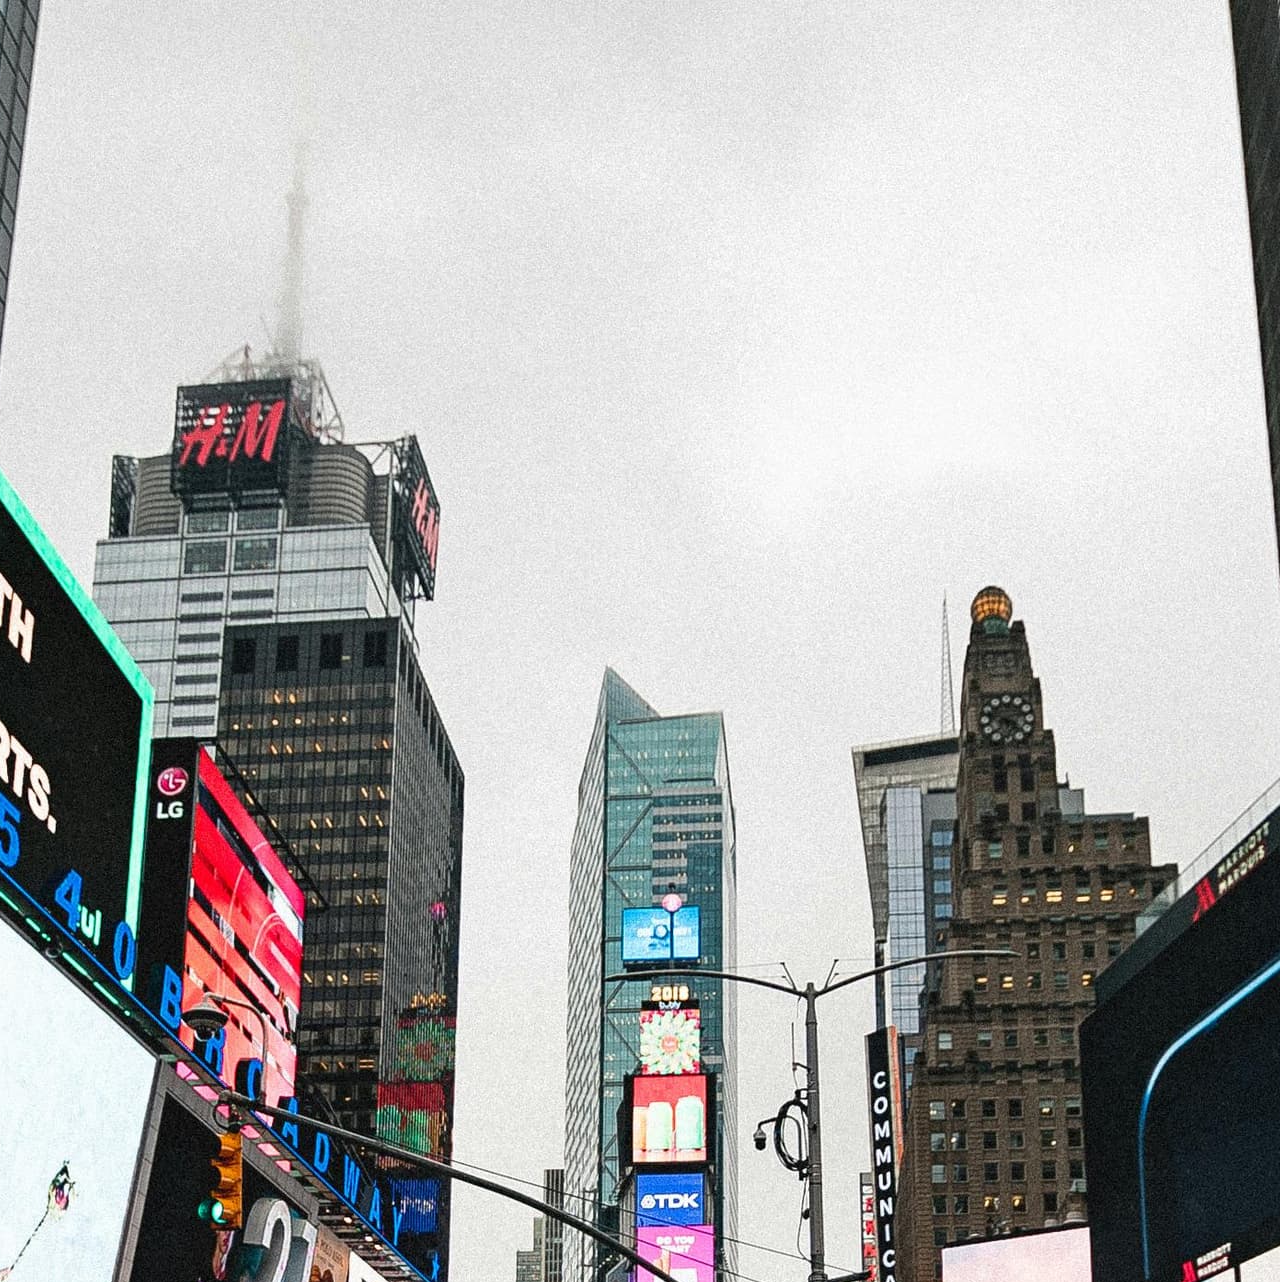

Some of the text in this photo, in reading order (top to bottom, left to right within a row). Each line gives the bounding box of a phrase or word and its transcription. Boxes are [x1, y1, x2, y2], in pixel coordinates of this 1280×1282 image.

[179, 399, 286, 467] H&M
[157, 801, 184, 820] LG
[655, 1194, 699, 1208] TDK
